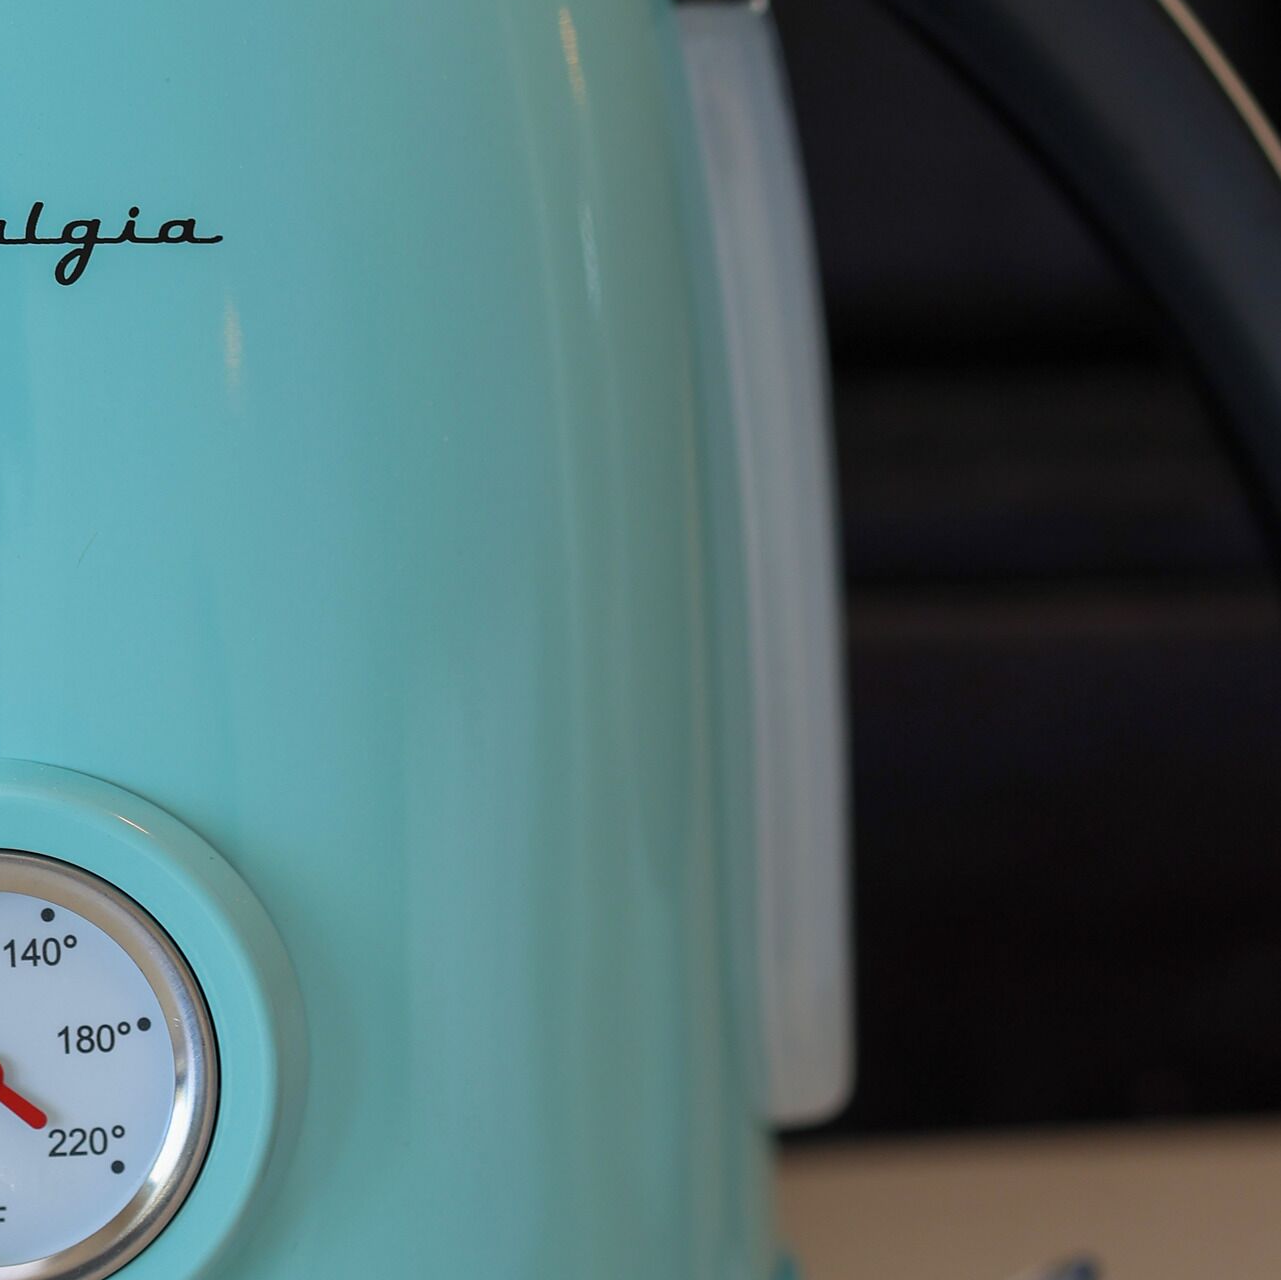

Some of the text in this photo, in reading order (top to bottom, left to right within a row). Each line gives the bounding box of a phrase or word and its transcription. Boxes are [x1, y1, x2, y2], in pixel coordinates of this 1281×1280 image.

[3, 935, 78, 968] 140°
[57, 1022, 132, 1055] 180°
[47, 1125, 126, 1157] 220°
